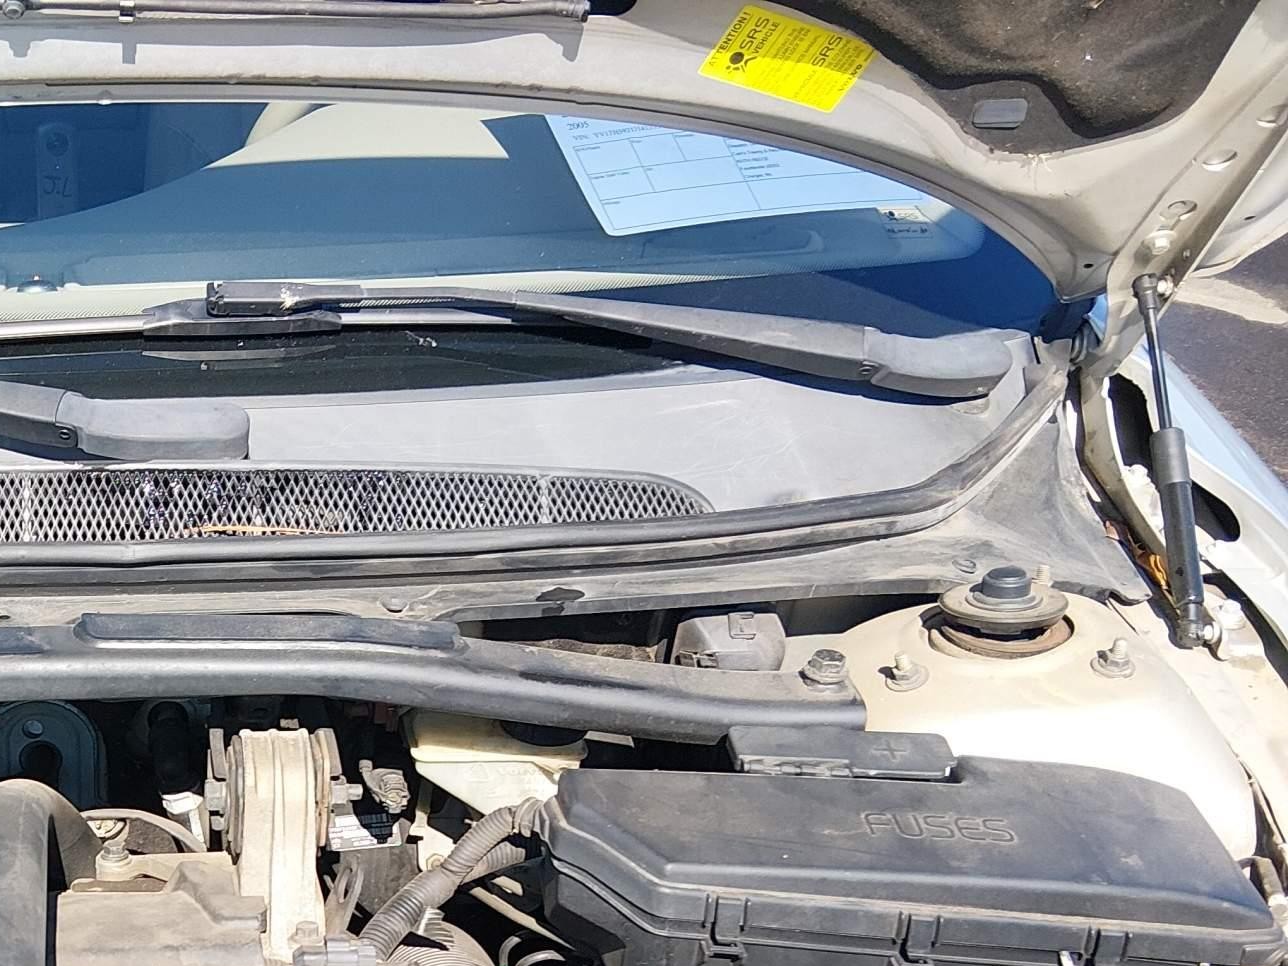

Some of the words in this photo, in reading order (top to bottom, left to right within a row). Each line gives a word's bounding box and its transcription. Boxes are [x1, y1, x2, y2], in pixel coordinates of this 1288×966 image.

[740, 16, 770, 50] SRS
[752, 21, 781, 55] VEHICLE
[812, 34, 842, 67] SRS
[567, 120, 590, 130] 2005
[863, 812, 1017, 844] FUSES
